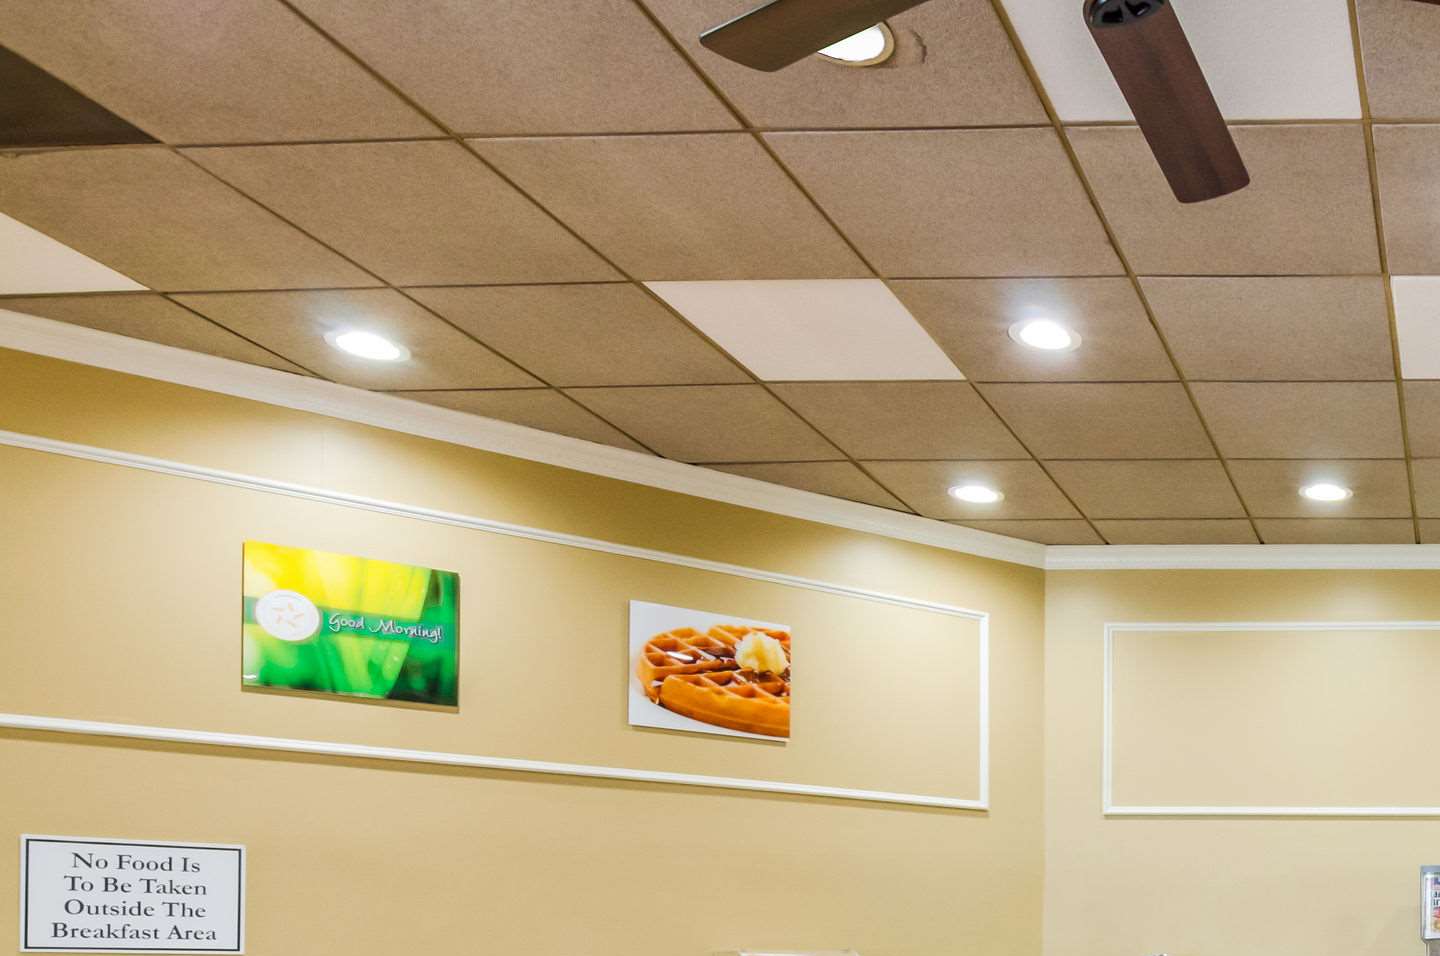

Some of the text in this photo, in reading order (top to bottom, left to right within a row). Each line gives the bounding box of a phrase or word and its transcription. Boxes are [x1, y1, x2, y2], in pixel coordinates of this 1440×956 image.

[328, 613, 442, 644] Good Morning!
[71, 852, 201, 873] No Food Is
[63, 875, 207, 896] To Be Taken
[64, 898, 207, 918] Outside The
[51, 922, 217, 941] Breakfast Area
